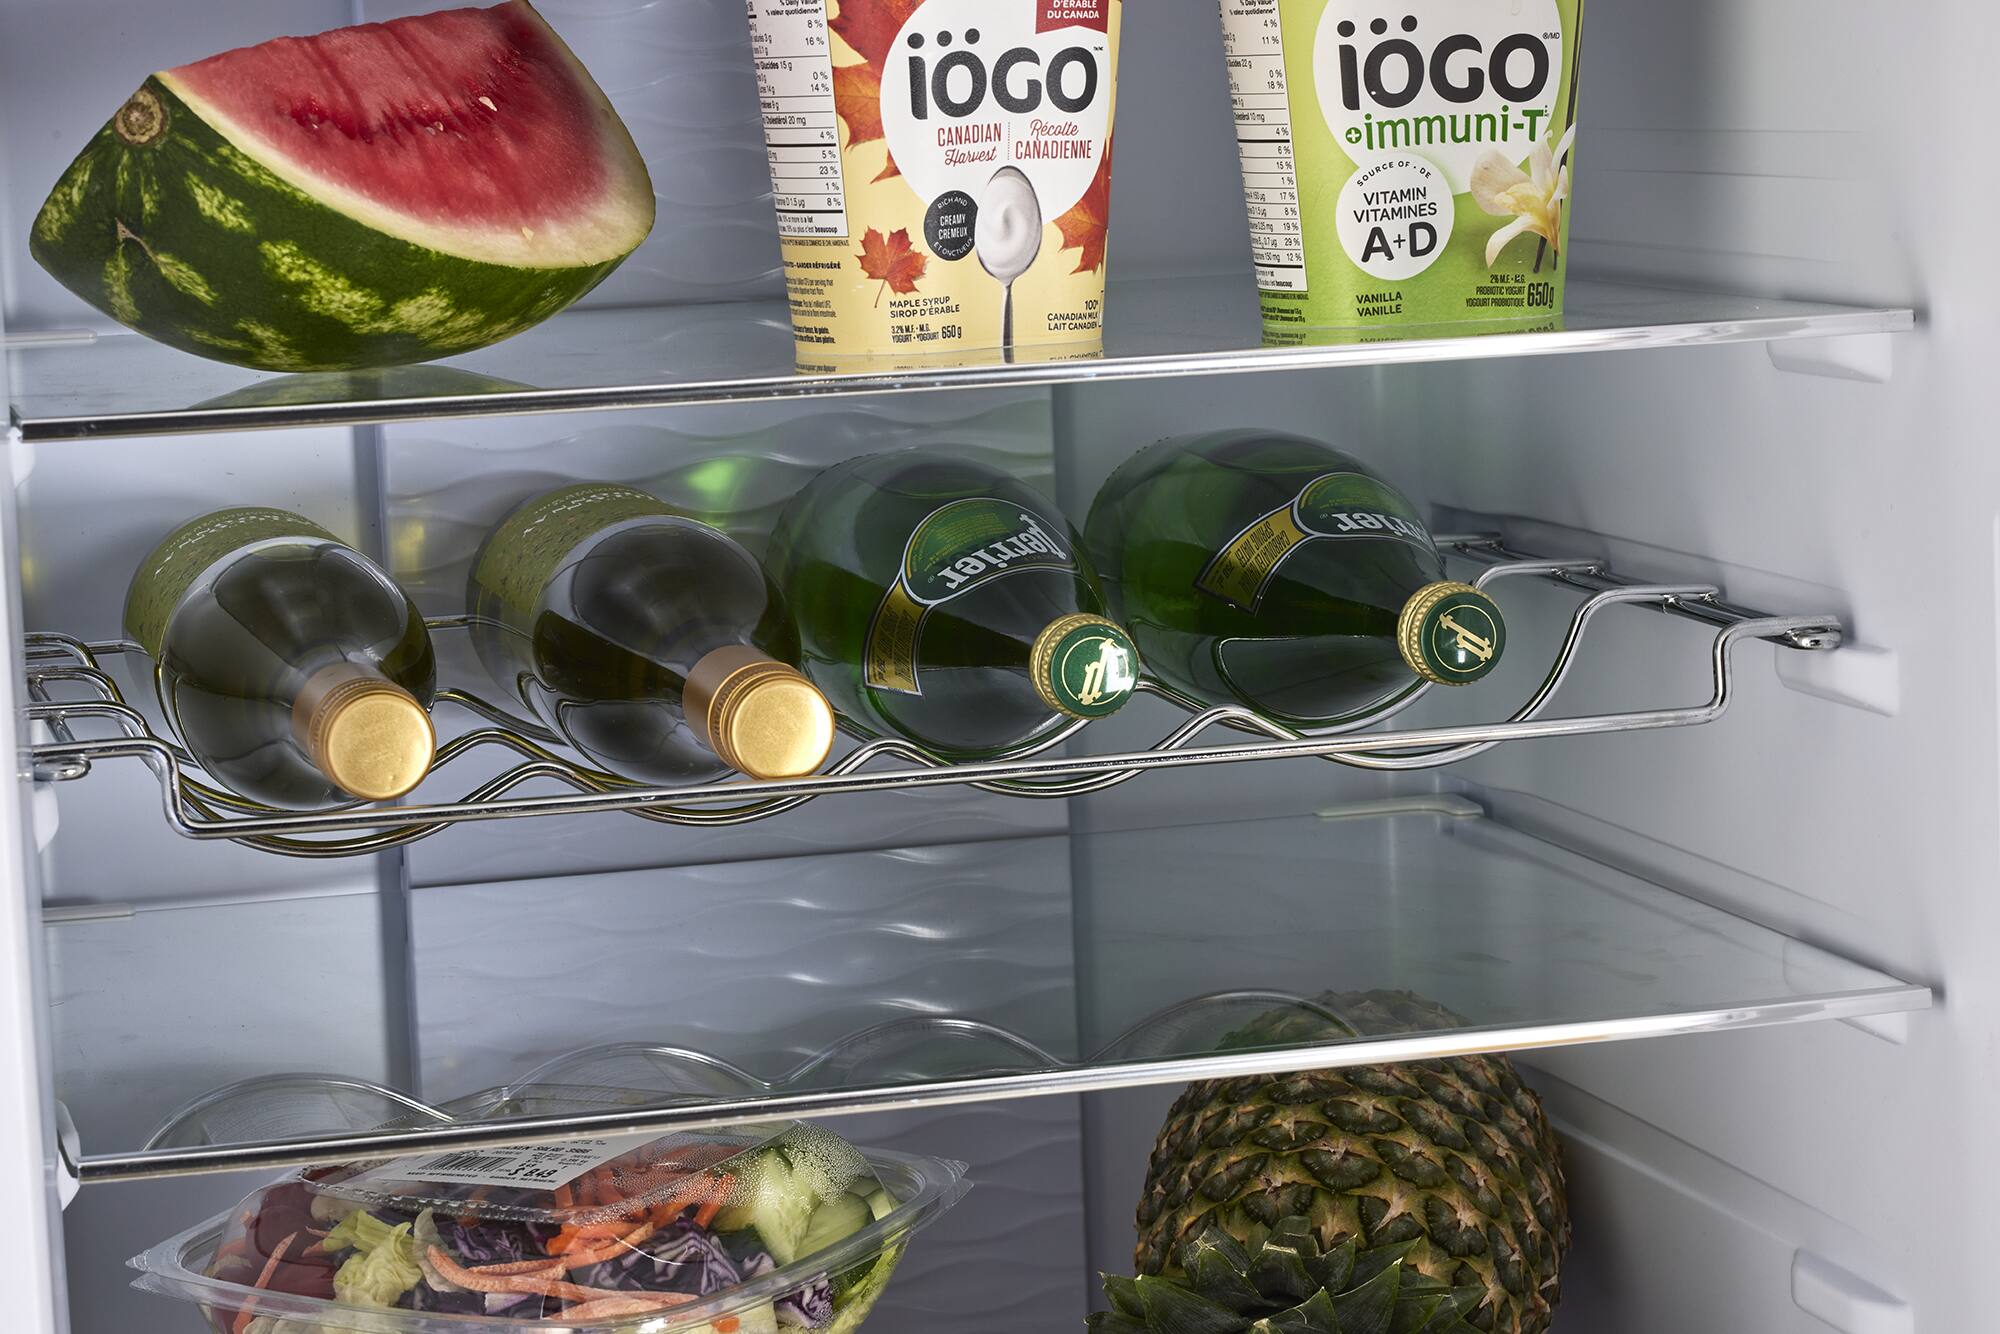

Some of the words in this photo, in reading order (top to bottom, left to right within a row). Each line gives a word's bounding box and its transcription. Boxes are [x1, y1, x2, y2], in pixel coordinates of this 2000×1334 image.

[1047, 10, 1061, 19] DU
[1063, 10, 1099, 19] CANADA
[788, 116, 795, 124] 20
[797, 117, 806, 126] mg
[937, 123, 1002, 147] CANADIAN
[1030, 119, 1079, 140] Récolte
[945, 146, 997, 167] Harvest
[1015, 140, 1092, 160] CANADIENNE
[1356, 162, 1395, 187] SOURCE
[1397, 160, 1411, 168] OF
[1419, 167, 1432, 179] DE
[1363, 186, 1427, 206] VITAMIN
[937, 198, 951, 209] RICH
[954, 197, 968, 206] AND
[1353, 202, 1437, 223] VITAMINES
[940, 213, 966, 226] CREAMY
[815, 226, 838, 234] beaucoup
[933, 241, 943, 251] ET
[1476, 286, 1504, 295] PROBIOTIC
[1505, 286, 1526, 295] YOGURT
[1527, 282, 1549, 307] 650
[889, 300, 920, 308] MAPLE
[922, 296, 951, 306] SYRUP
[1356, 292, 1403, 304] VANILLA
[1466, 298, 1490, 307] YOGOURT
[1491, 298, 1525, 307] PROBIOTIQUE
[889, 309, 918, 318] SIROP
[919, 304, 961, 316] D'ÉRABLE
[1047, 312, 1087, 321] CANADIAN
[1357, 304, 1402, 317] VANILLE
[941, 325, 956, 339] 650
[956, 326, 962, 339] g
